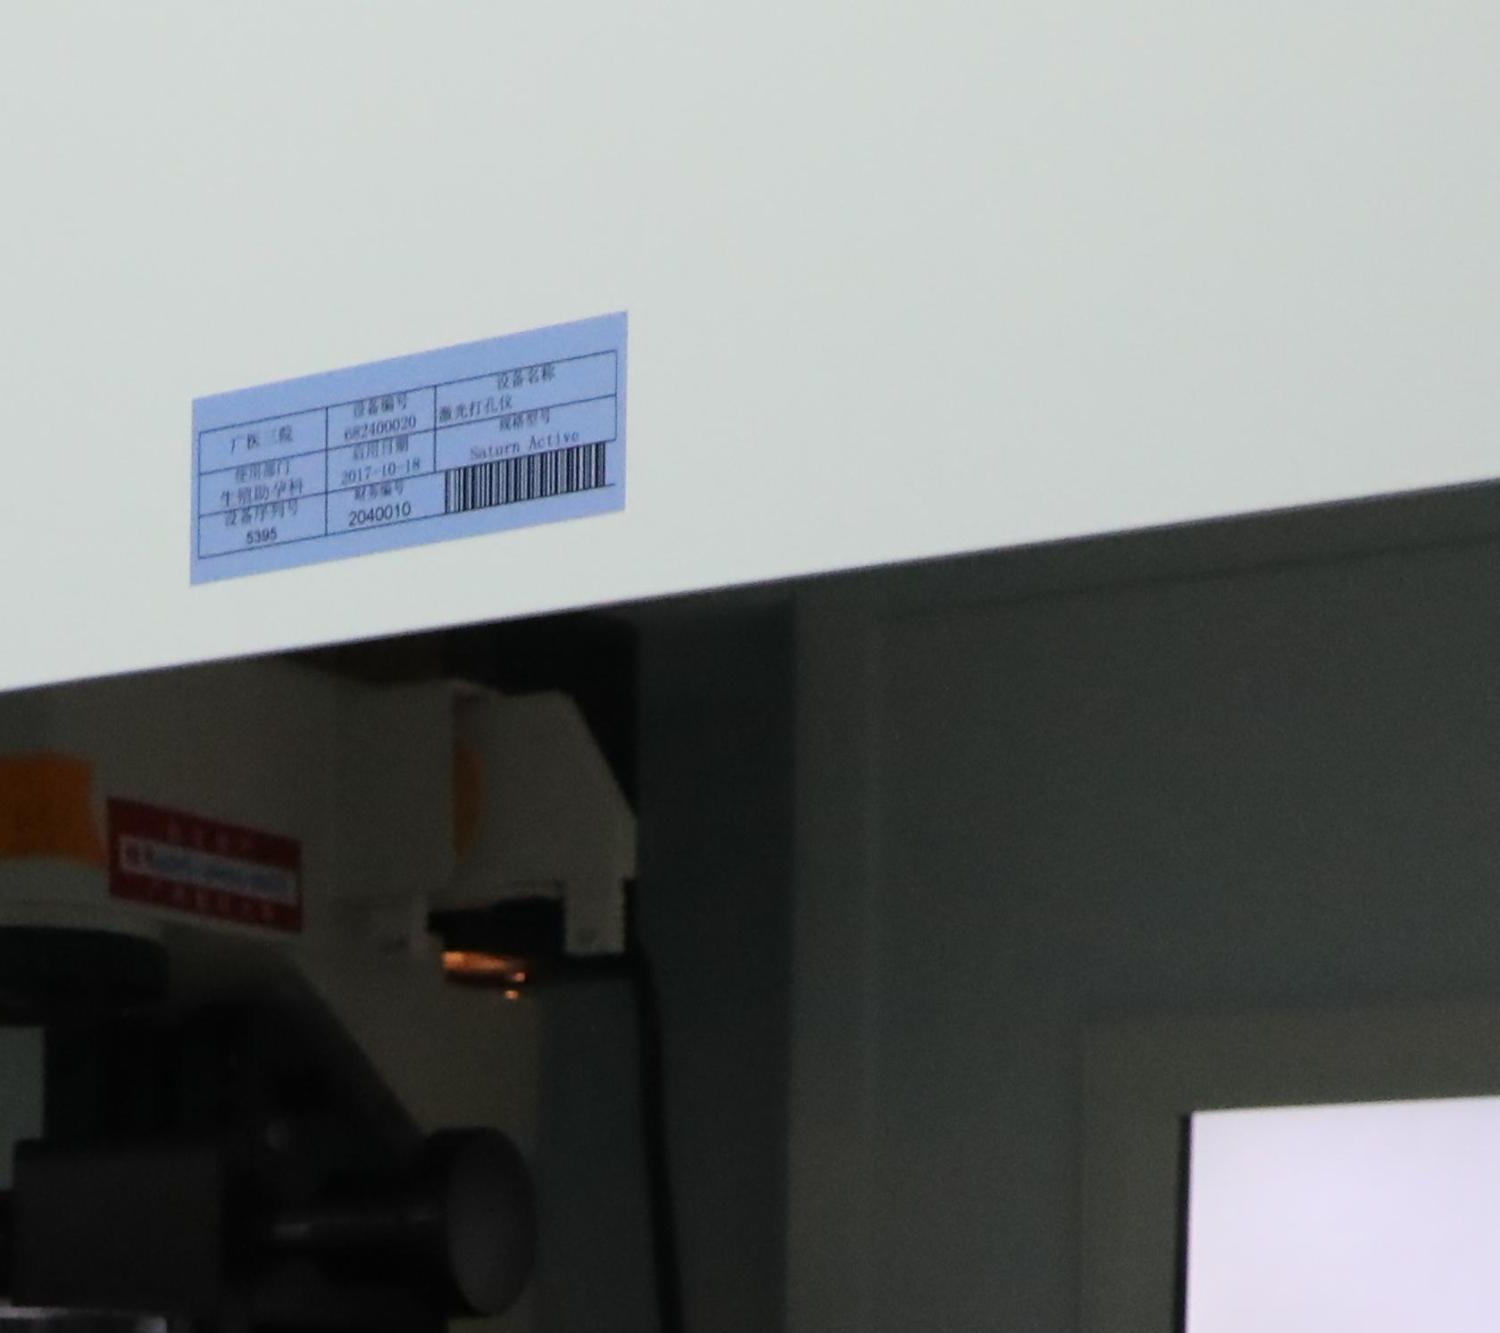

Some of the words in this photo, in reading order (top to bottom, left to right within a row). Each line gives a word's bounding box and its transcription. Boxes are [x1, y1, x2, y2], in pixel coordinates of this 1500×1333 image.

[496, 366, 556, 390] 设备名称
[439, 394, 513, 422] 激光打孔仪
[529, 431, 580, 451] Active
[341, 459, 421, 485] 2017-10-18
[348, 501, 412, 527] 2040010
[246, 527, 278, 545] 5395
